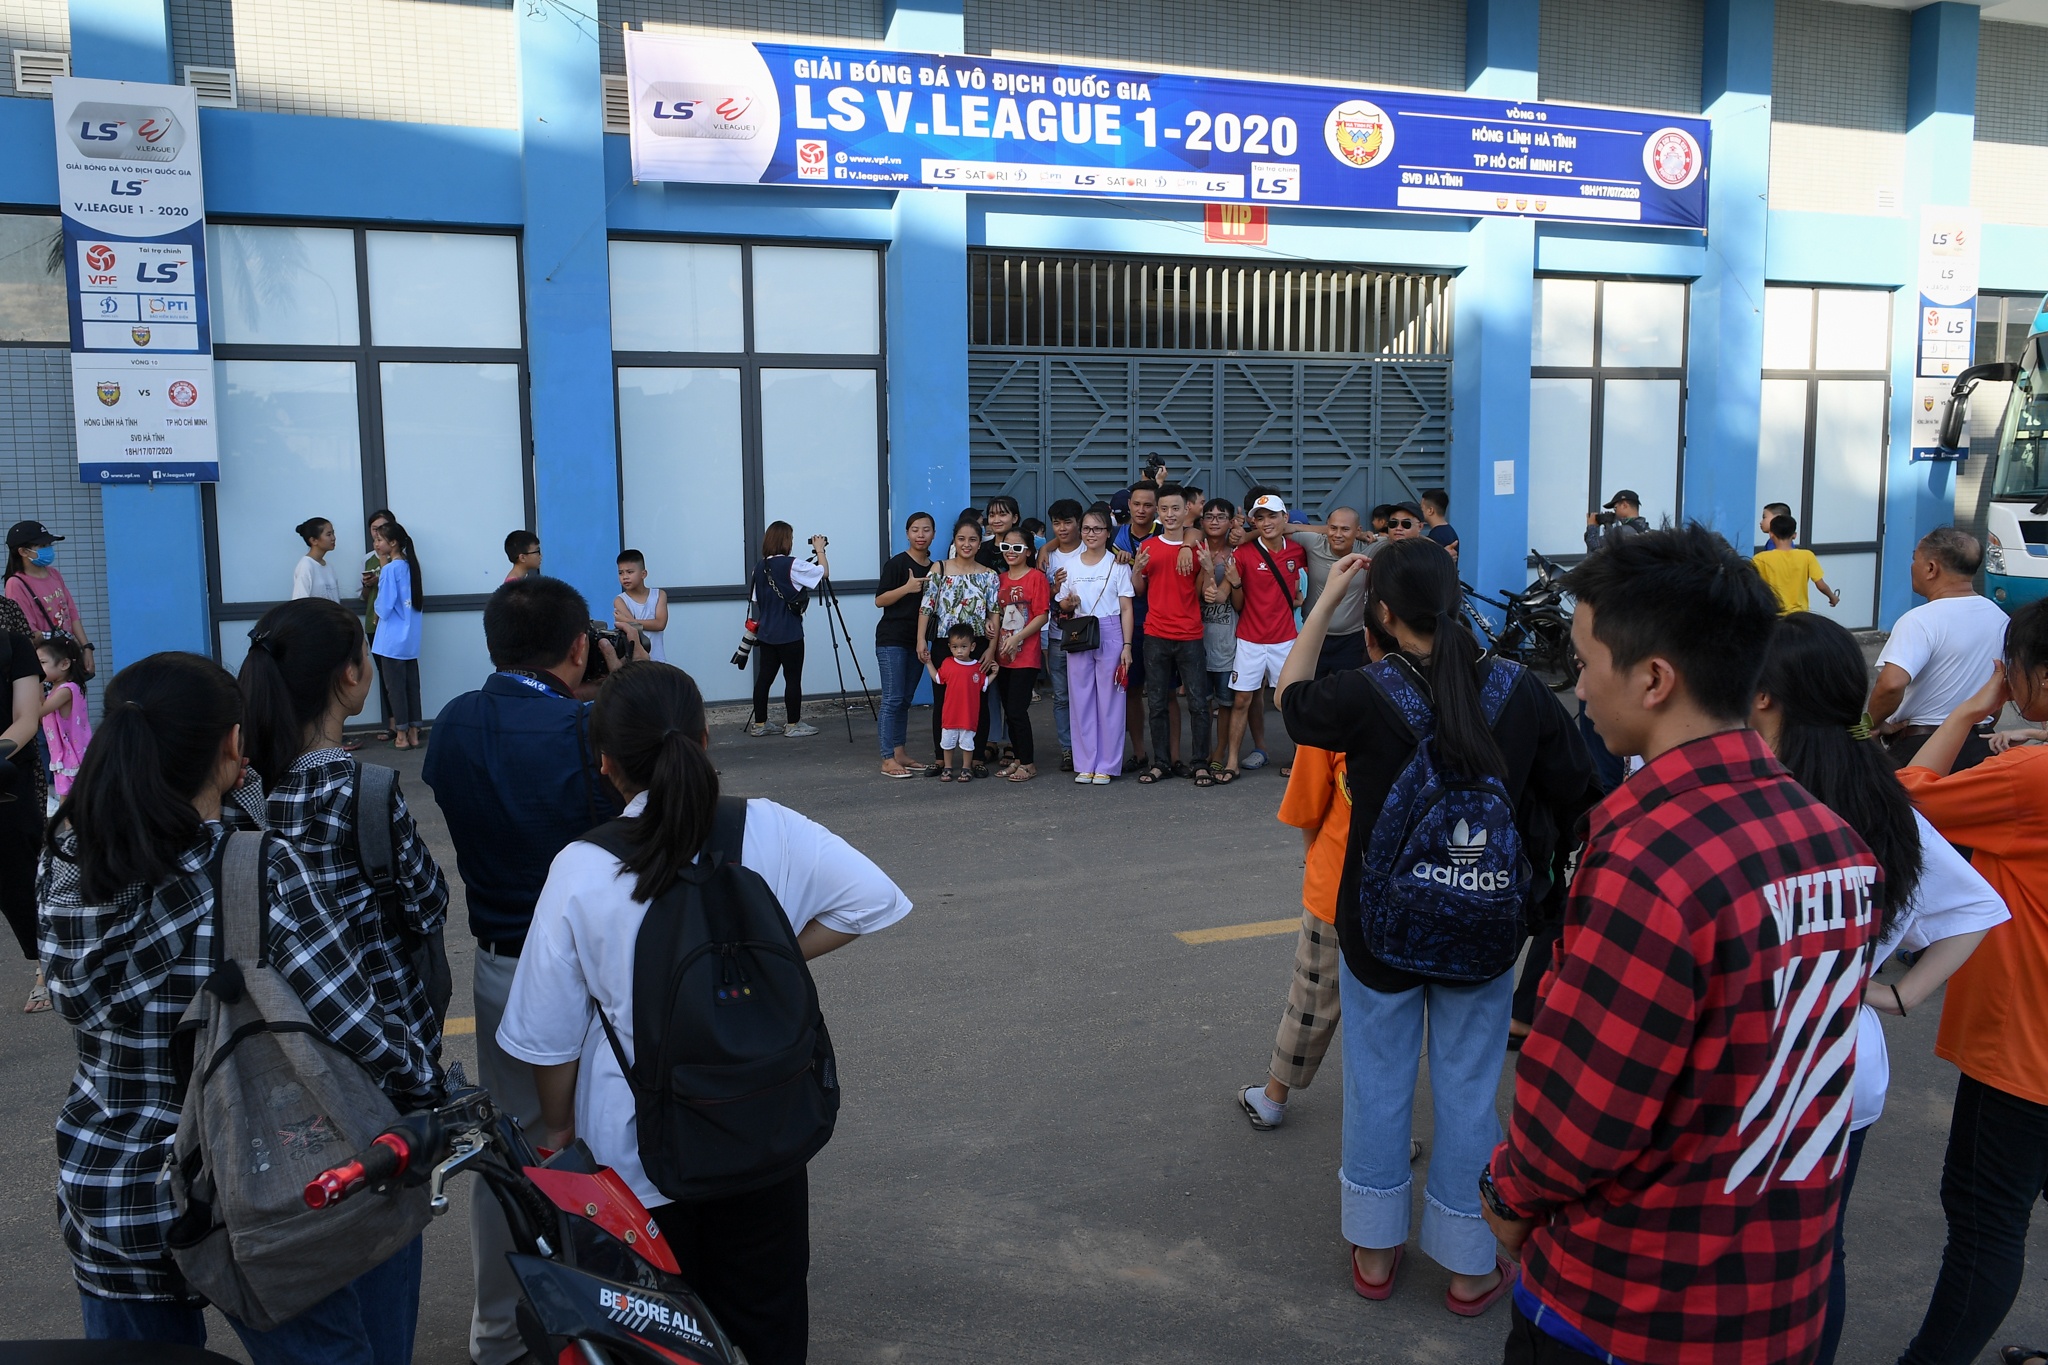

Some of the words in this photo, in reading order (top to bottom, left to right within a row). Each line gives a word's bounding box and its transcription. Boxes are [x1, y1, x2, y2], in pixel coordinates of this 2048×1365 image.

[793, 55, 842, 81] GIẢI
[849, 59, 912, 85] BÓNG
[918, 64, 950, 88] ĐÁ
[955, 66, 986, 91] VÔ
[991, 72, 1046, 96] ĐỊCH
[1051, 74, 1111, 99] QUỐC
[1116, 81, 1152, 102] GIA
[653, 100, 694, 120] LS
[794, 84, 866, 132] LS
[876, 89, 1122, 147] V.LEAGUE
[1506, 107, 1535, 121] VÒNG
[1536, 112, 1547, 121] 10
[80, 121, 118, 141] LS
[713, 123, 751, 131] V.LEAGUE
[1534, 131, 1551, 147] HÀ
[136, 145, 171, 153] V.LEAGUE
[849, 155, 902, 165] www.vpf.vn
[1473, 153, 1489, 167] TP
[1508, 154, 1527, 170] CHÍ
[1530, 158, 1557, 172] MINH
[1558, 160, 1573, 173] FC
[84, 164, 107, 172] BÓNG
[135, 167, 153, 175] ĐỊCH
[800, 166, 826, 175] VPF
[849, 171, 909, 182] V.league.VPF
[933, 168, 956, 179] LS
[1074, 175, 1096, 185] LS
[1256, 177, 1288, 194] LS
[1401, 172, 1423, 184] SVĐ
[1425, 172, 1440, 186] HÀ
[110, 179, 142, 197] LS
[1206, 181, 1226, 192] LS
[1579, 183, 1640, 200] 18H/17/07/2020
[74, 202, 134, 214] V.LEAGUE
[139, 205, 144, 214] 1
[158, 206, 189, 217] 2020
[1220, 204, 1252, 236] VIP
[1932, 233, 1948, 245] LS
[87, 274, 118, 285] VPF
[136, 262, 178, 283] LS
[1941, 269, 1954, 279] LS
[167, 301, 188, 311] PTI
[1946, 321, 1964, 334] LS
[124, 447, 173, 456] 18H/17/07/2020
[522, 678, 538, 689] VPF
[1411, 860, 1511, 892] adidas
[599, 1287, 670, 1326] BEFORE
[671, 1311, 703, 1337] ALL
[658, 1325, 715, 1348] HI-POWER
